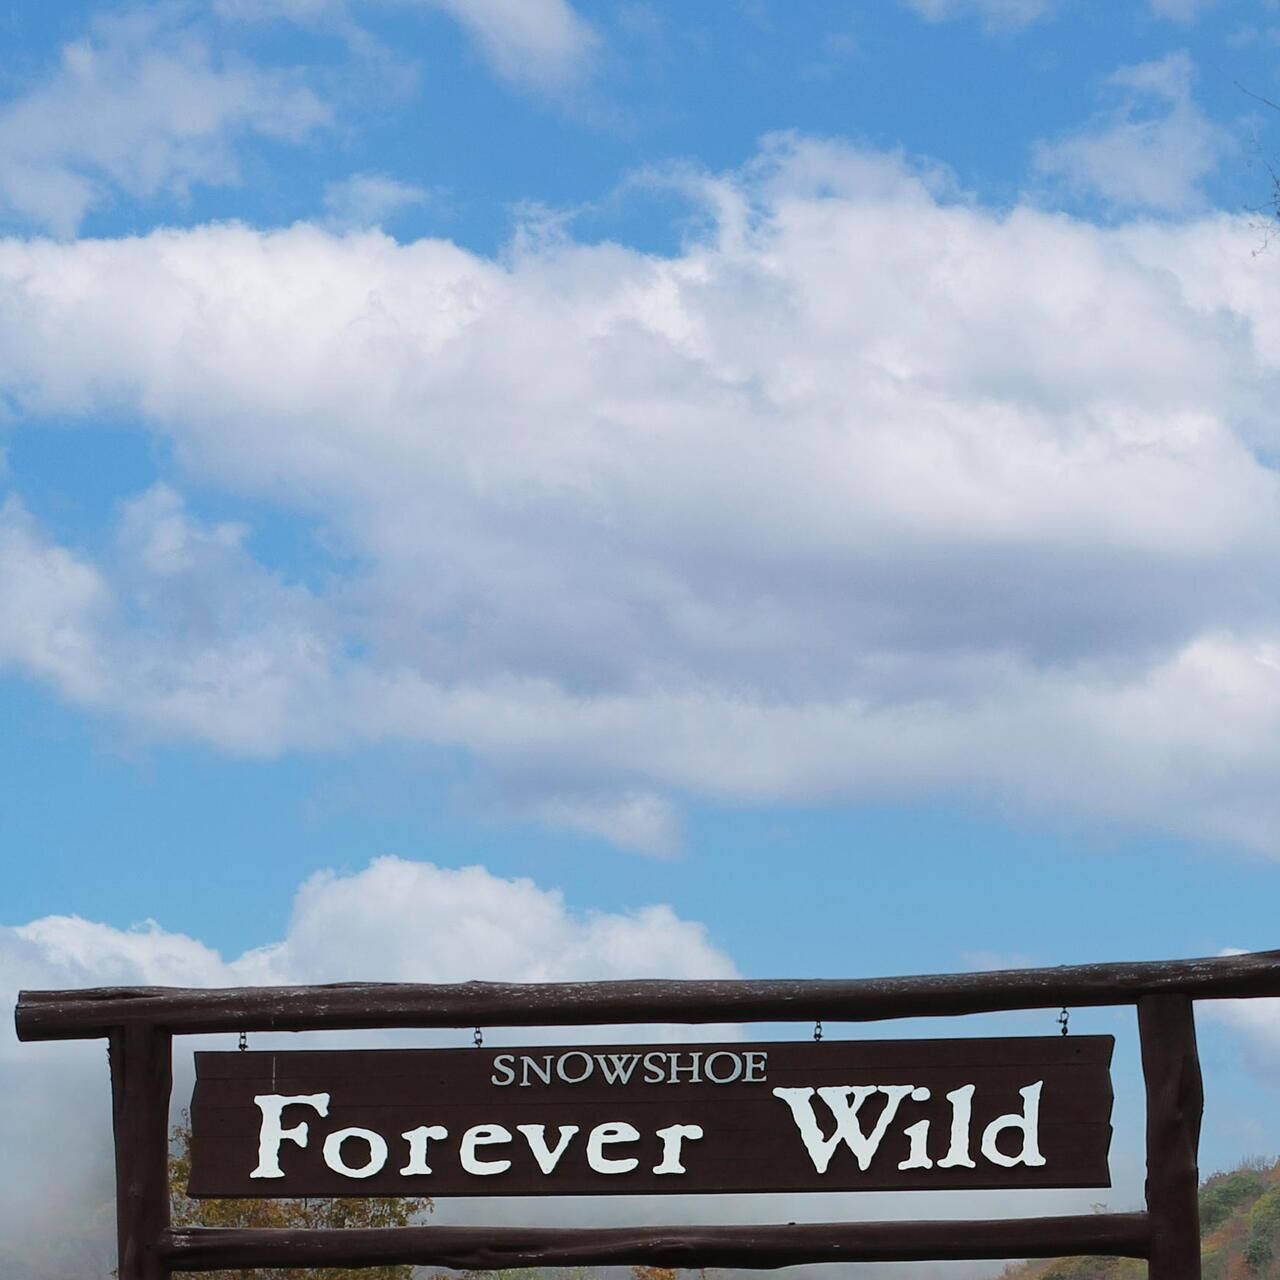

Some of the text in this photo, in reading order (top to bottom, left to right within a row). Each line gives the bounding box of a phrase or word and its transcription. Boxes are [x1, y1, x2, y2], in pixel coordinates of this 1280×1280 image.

[490, 1051, 769, 1087] SNOWSHOE
[248, 1080, 1048, 1180] Forever Wild
